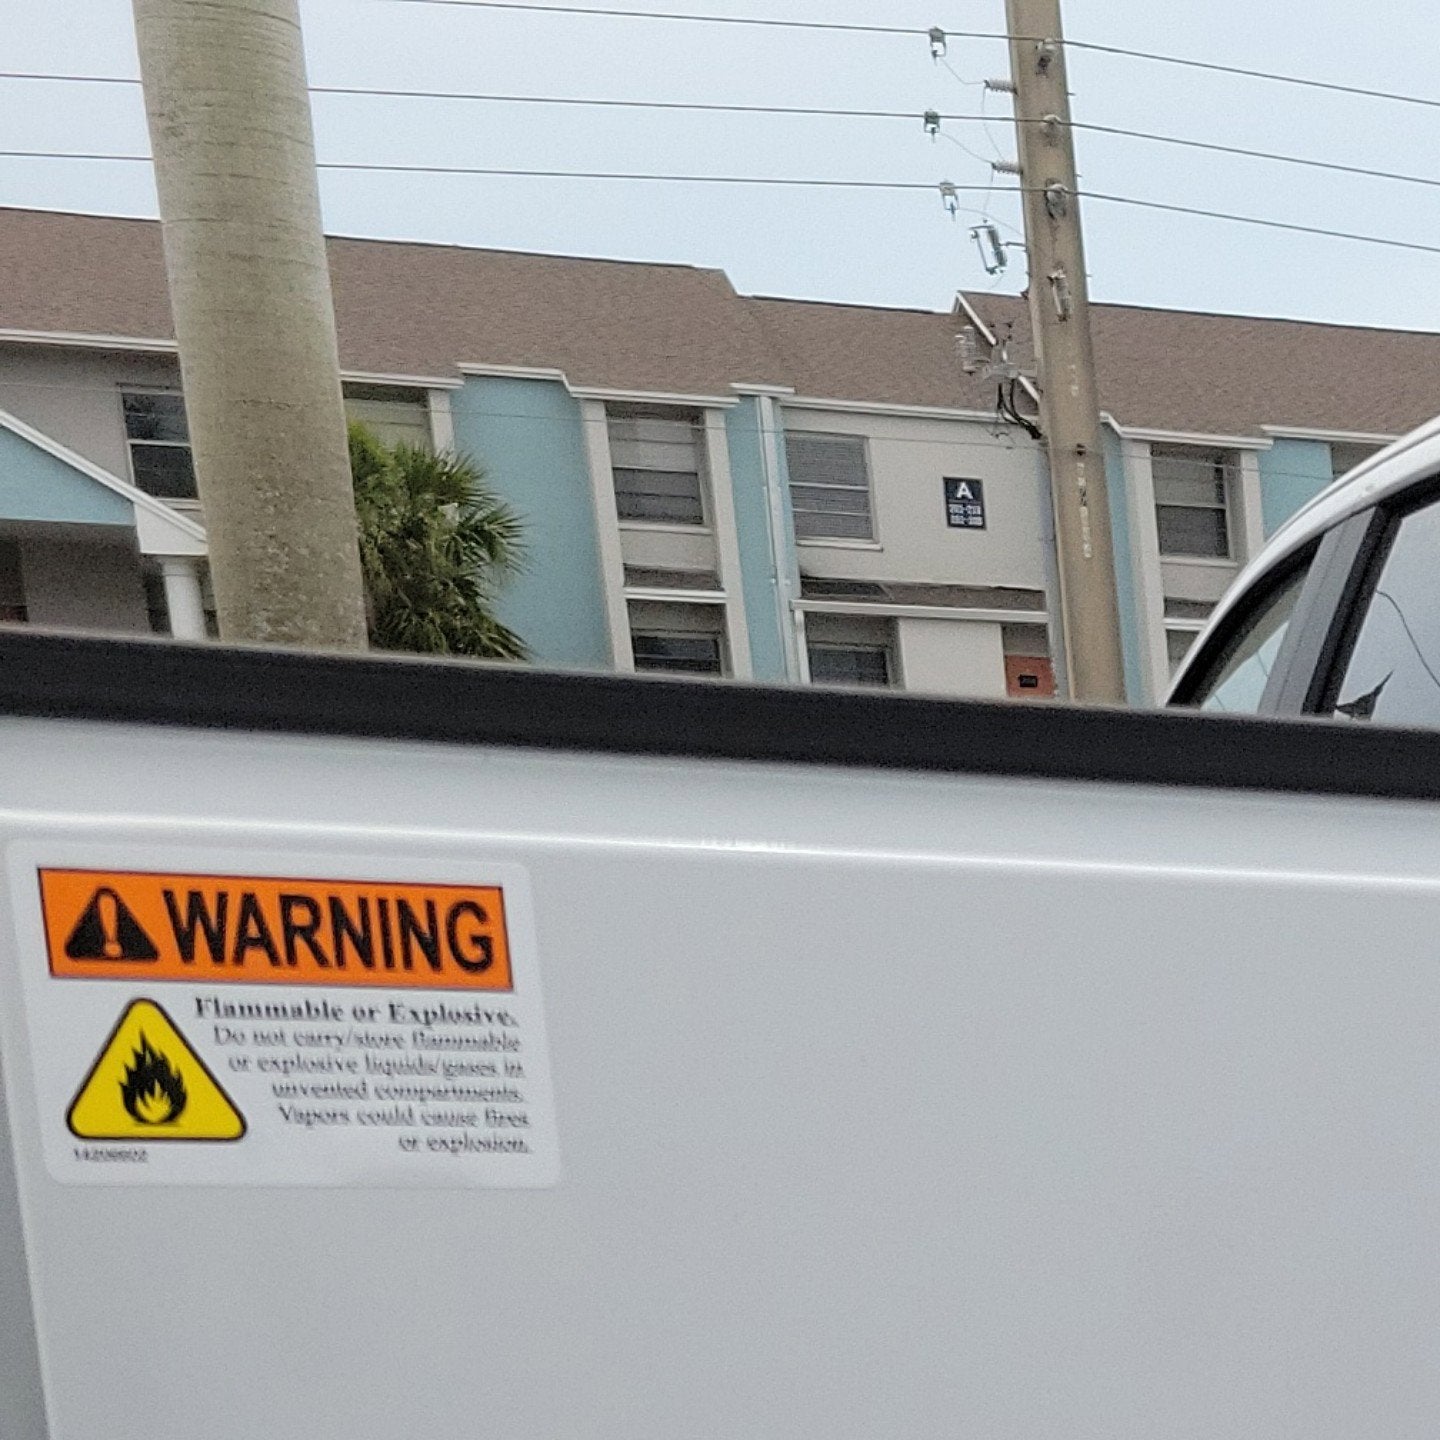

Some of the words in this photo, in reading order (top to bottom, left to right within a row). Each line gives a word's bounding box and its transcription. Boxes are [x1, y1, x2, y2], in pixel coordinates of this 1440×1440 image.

[956, 482, 974, 500] A
[162, 888, 495, 974] WARNING
[195, 996, 345, 1022] Flammable
[352, 1006, 381, 1023] or
[388, 999, 520, 1030] Explosive.
[213, 1024, 246, 1047] Do
[253, 1027, 287, 1047] not
[293, 1027, 406, 1052] carry/store
[411, 1030, 522, 1053] flammable
[228, 1055, 252, 1072] or
[257, 1053, 359, 1077] explosive
[503, 1056, 525, 1078] in
[271, 1078, 368, 1099] unvented
[278, 1102, 351, 1129] Vapors
[356, 1103, 416, 1127] could
[420, 1110, 479, 1128] cause
[398, 1135, 418, 1152] or
